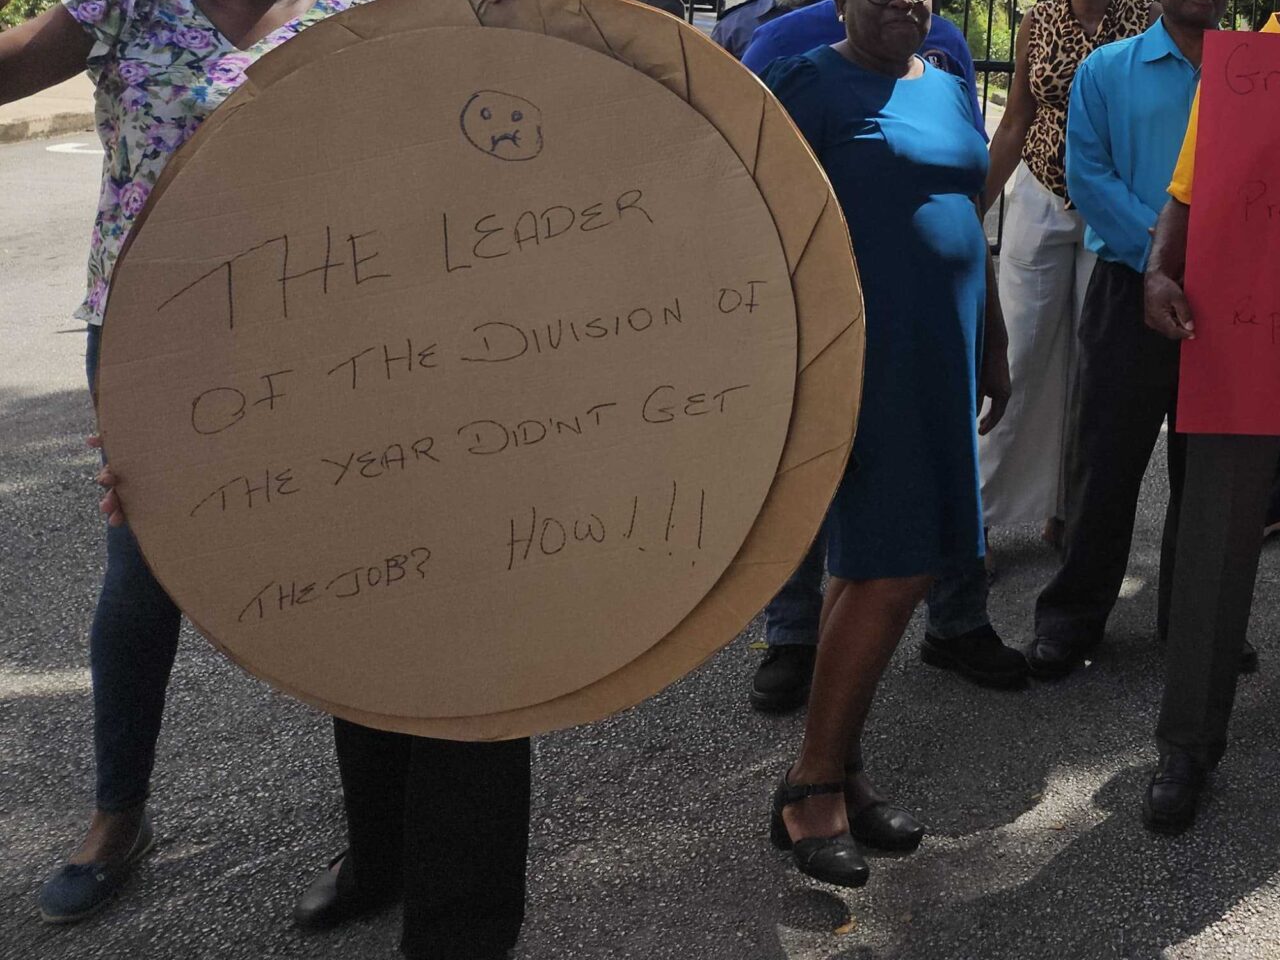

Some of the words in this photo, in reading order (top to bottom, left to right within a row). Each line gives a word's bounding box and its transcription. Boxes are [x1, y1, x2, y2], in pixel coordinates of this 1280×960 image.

[157, 225, 391, 330] THE
[443, 189, 654, 273] LEADER
[191, 369, 294, 435] OF
[327, 338, 438, 390] THE
[460, 297, 683, 362] DIVISION
[717, 280, 768, 314] OF
[190, 468, 300, 518] THE
[320, 436, 441, 486] YEAR
[641, 384, 750, 424] GET
[238, 580, 318, 623] THE
[324, 547, 432, 599] JOB?
